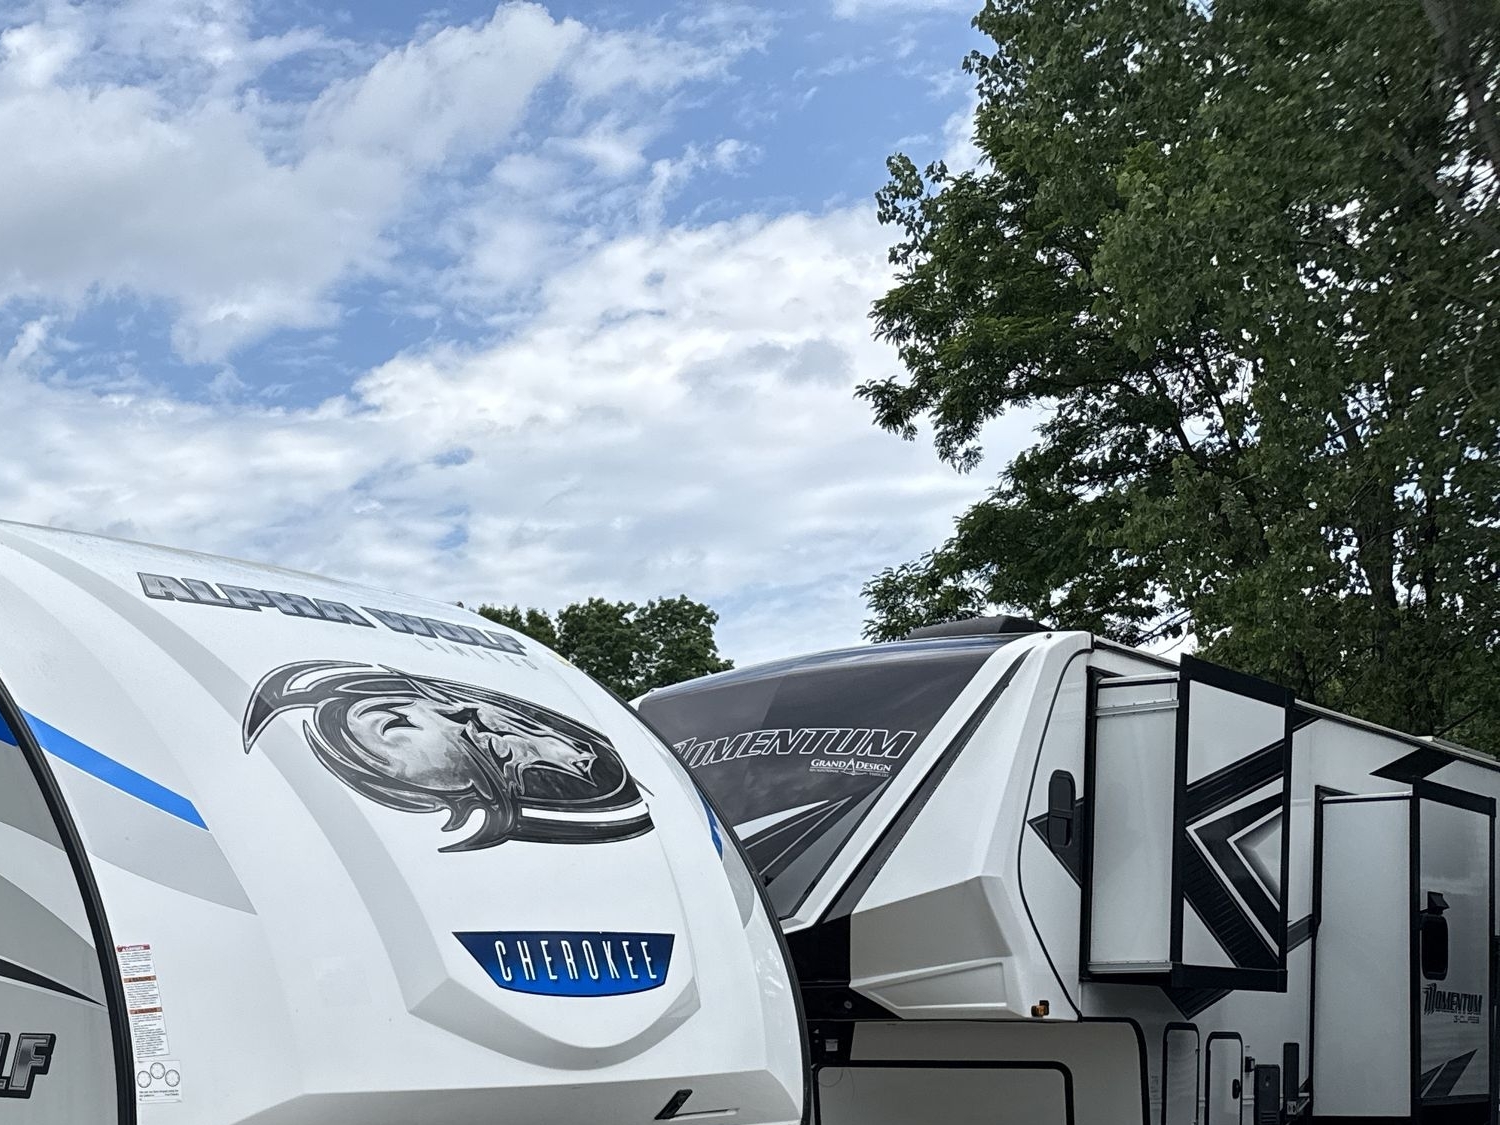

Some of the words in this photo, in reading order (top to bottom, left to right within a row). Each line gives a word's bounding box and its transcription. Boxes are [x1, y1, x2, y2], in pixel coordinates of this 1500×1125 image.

[137, 572, 376, 628] ALPHA
[360, 606, 528, 656] WOLF
[414, 637, 539, 670] LIMITED
[674, 728, 917, 768] MOMENTUM
[810, 758, 847, 768] GRAND
[855, 760, 893, 772] DESIGN
[494, 940, 658, 982] CHEROKEE
[1422, 983, 1483, 1015] MOMENTUM
